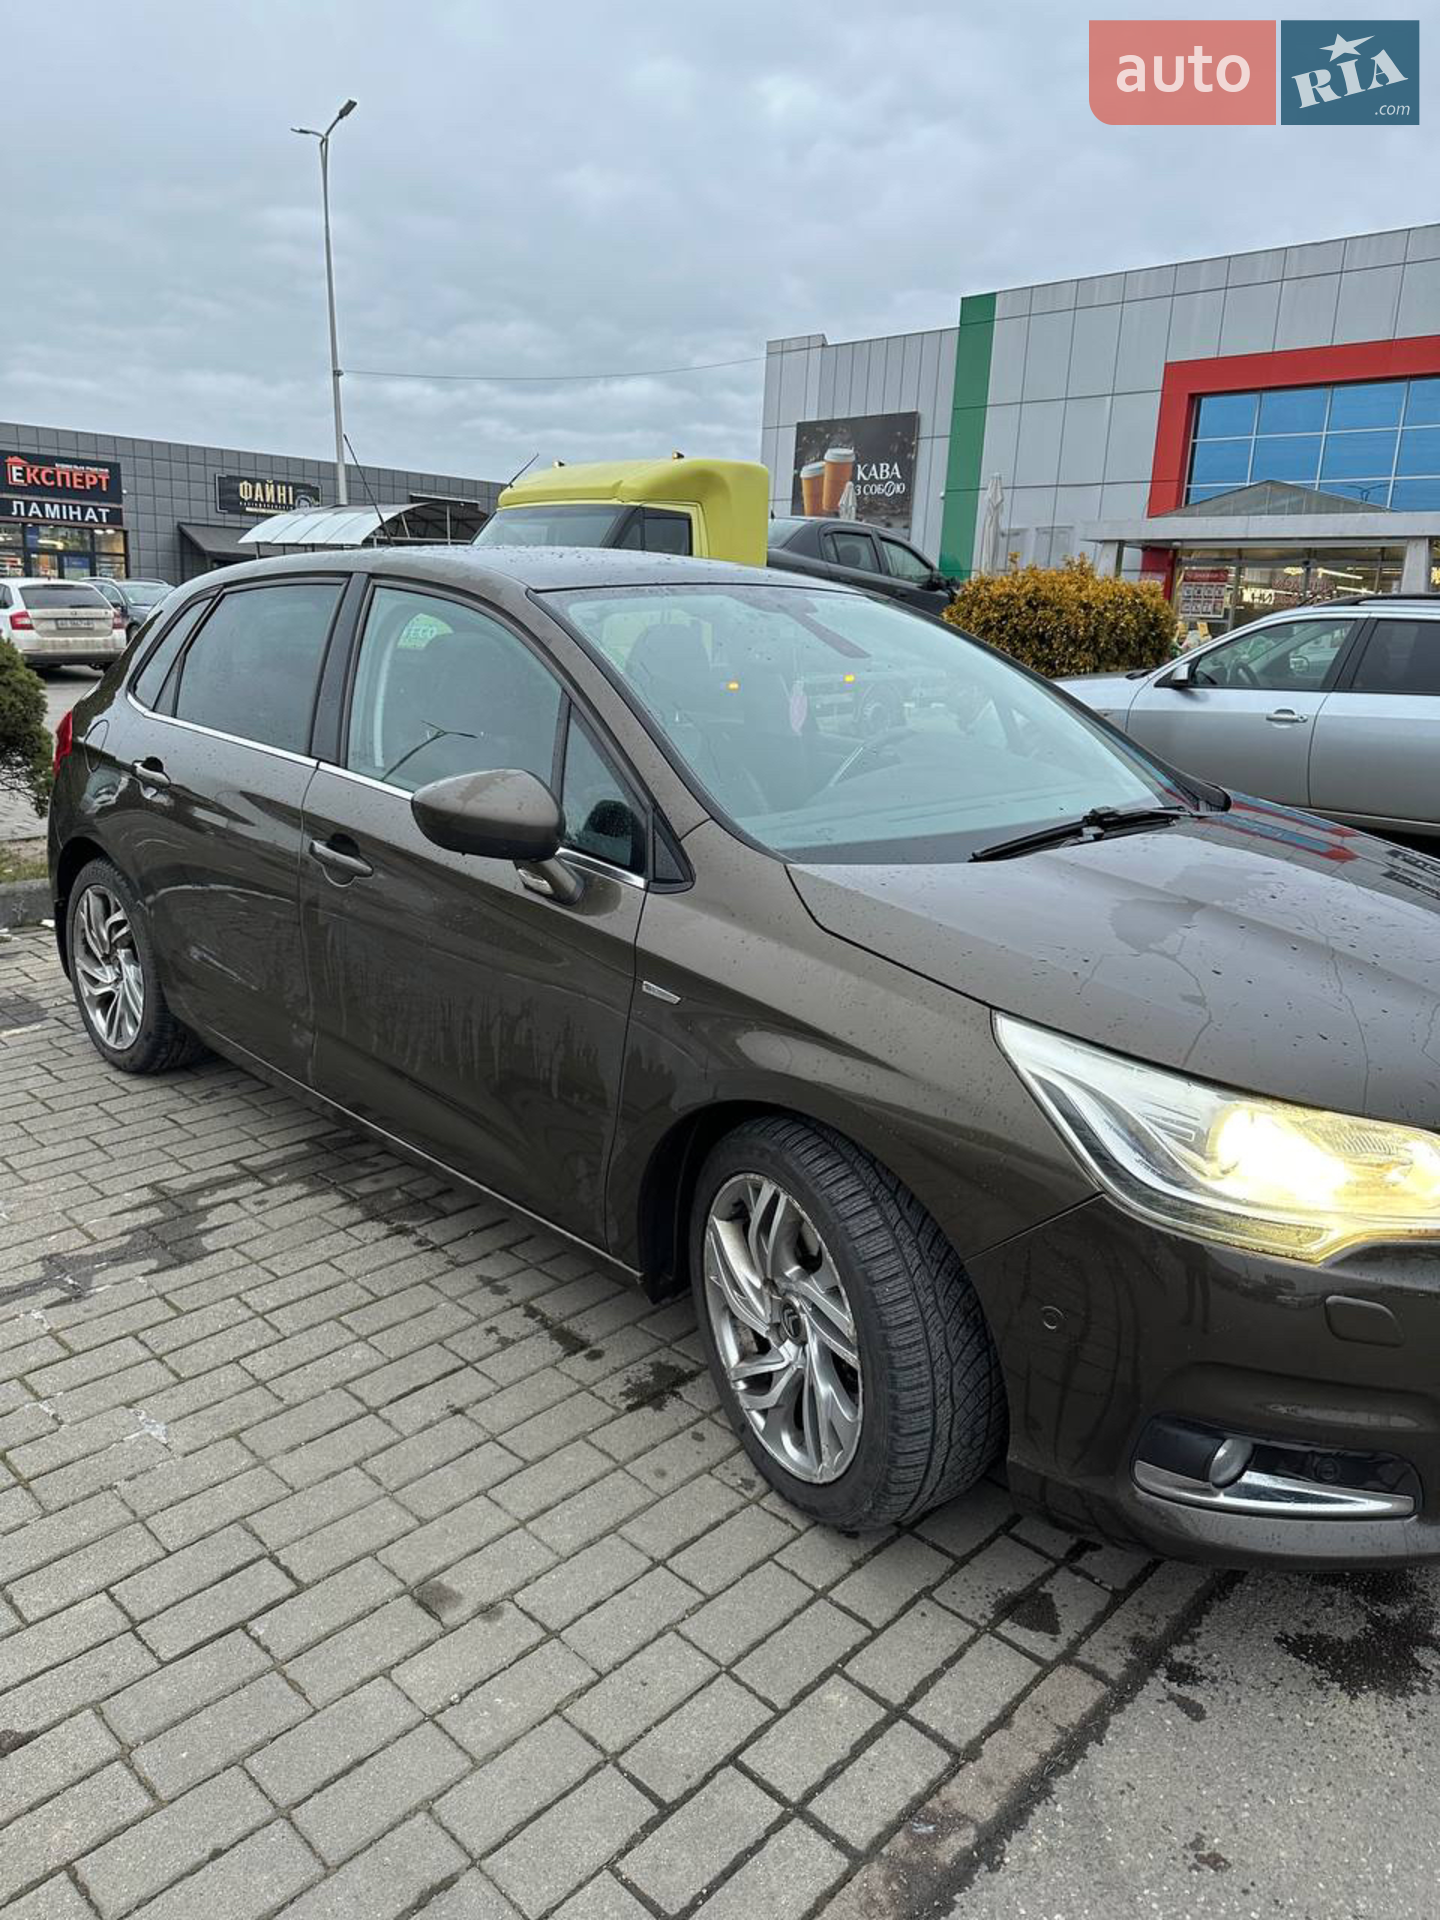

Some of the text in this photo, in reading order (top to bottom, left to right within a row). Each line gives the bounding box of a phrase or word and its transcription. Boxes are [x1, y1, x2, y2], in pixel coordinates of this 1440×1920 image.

[11, 465, 110, 491] ЕКСПЕРТ
[857, 462, 901, 481] КАВА
[239, 480, 294, 505] ФАЙНІ
[11, 500, 110, 523] ЛАМІНАТ
